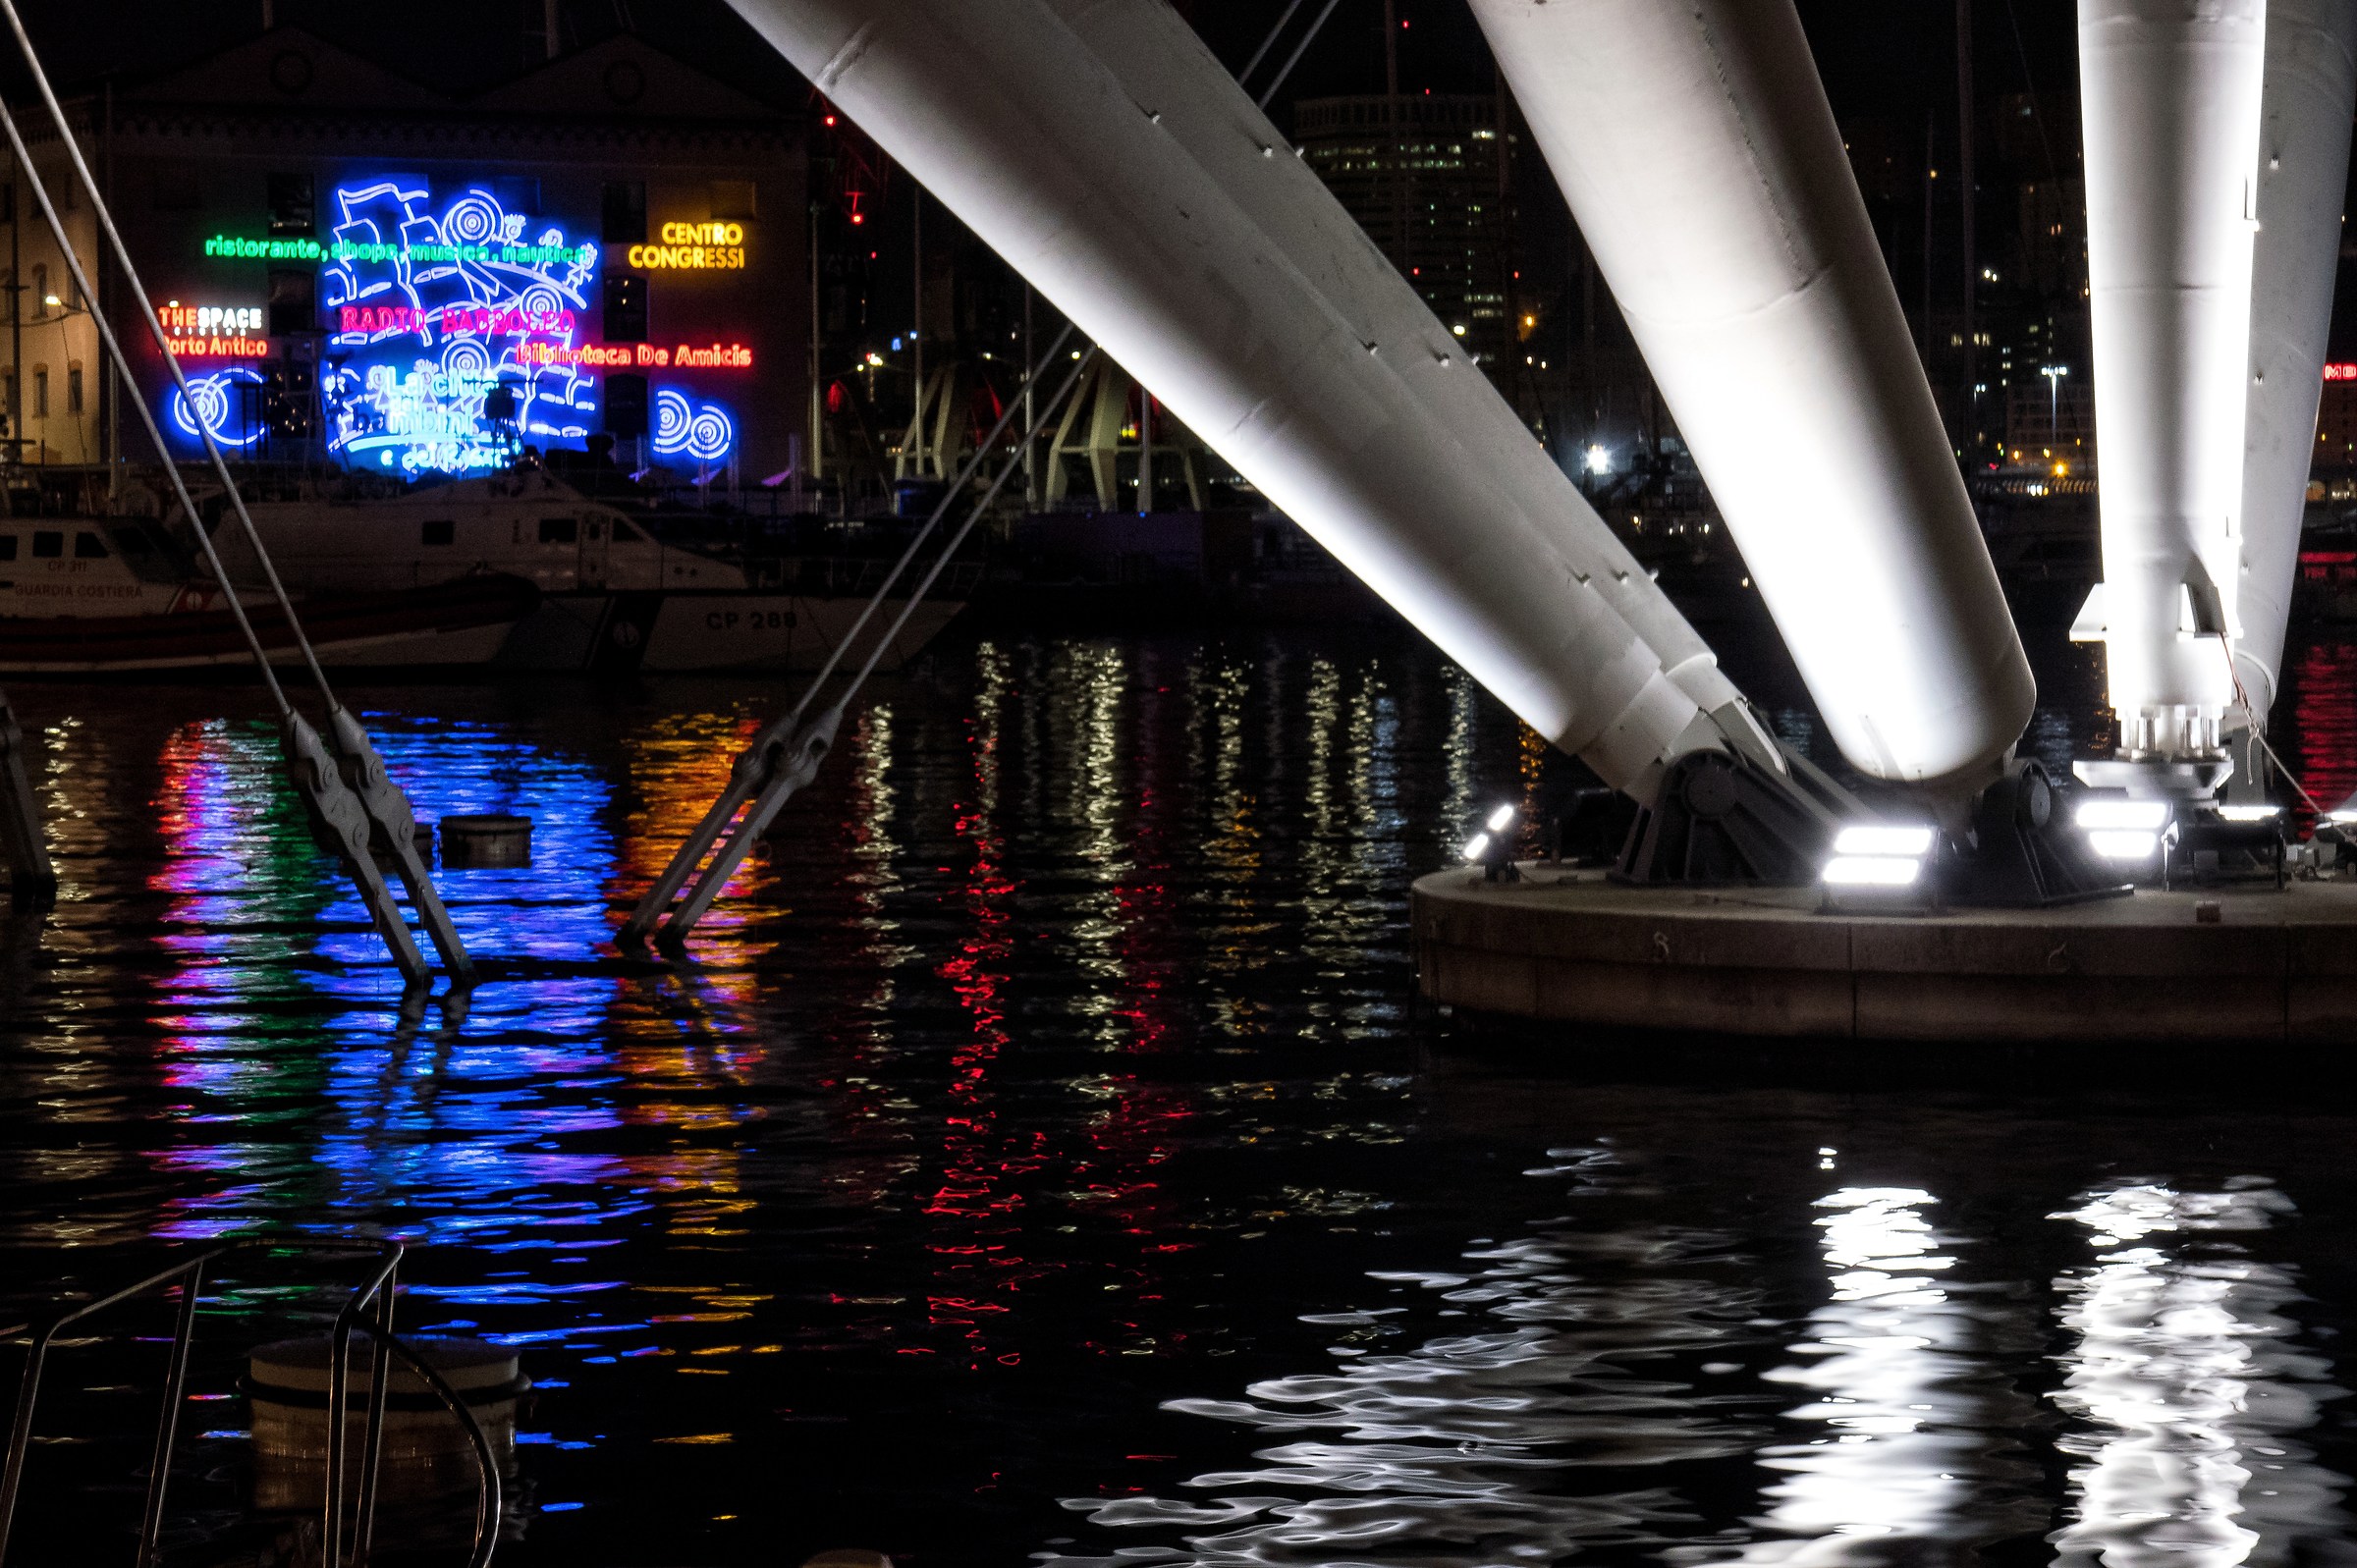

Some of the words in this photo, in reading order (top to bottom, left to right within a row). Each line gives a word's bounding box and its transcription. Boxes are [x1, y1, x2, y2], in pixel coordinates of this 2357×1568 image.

[662, 222, 743, 245] CENTRO
[502, 243, 587, 263] nautica
[629, 246, 745, 269] CONGRESSI
[342, 306, 427, 333] RADIO
[209, 336, 267, 356] Antico
[516, 343, 631, 366] Biblioteca
[637, 345, 669, 366] De
[675, 345, 752, 367] Amicis
[15, 584, 74, 598] GUARDIA
[77, 585, 143, 598] COSTIERA
[705, 612, 739, 630] CP
